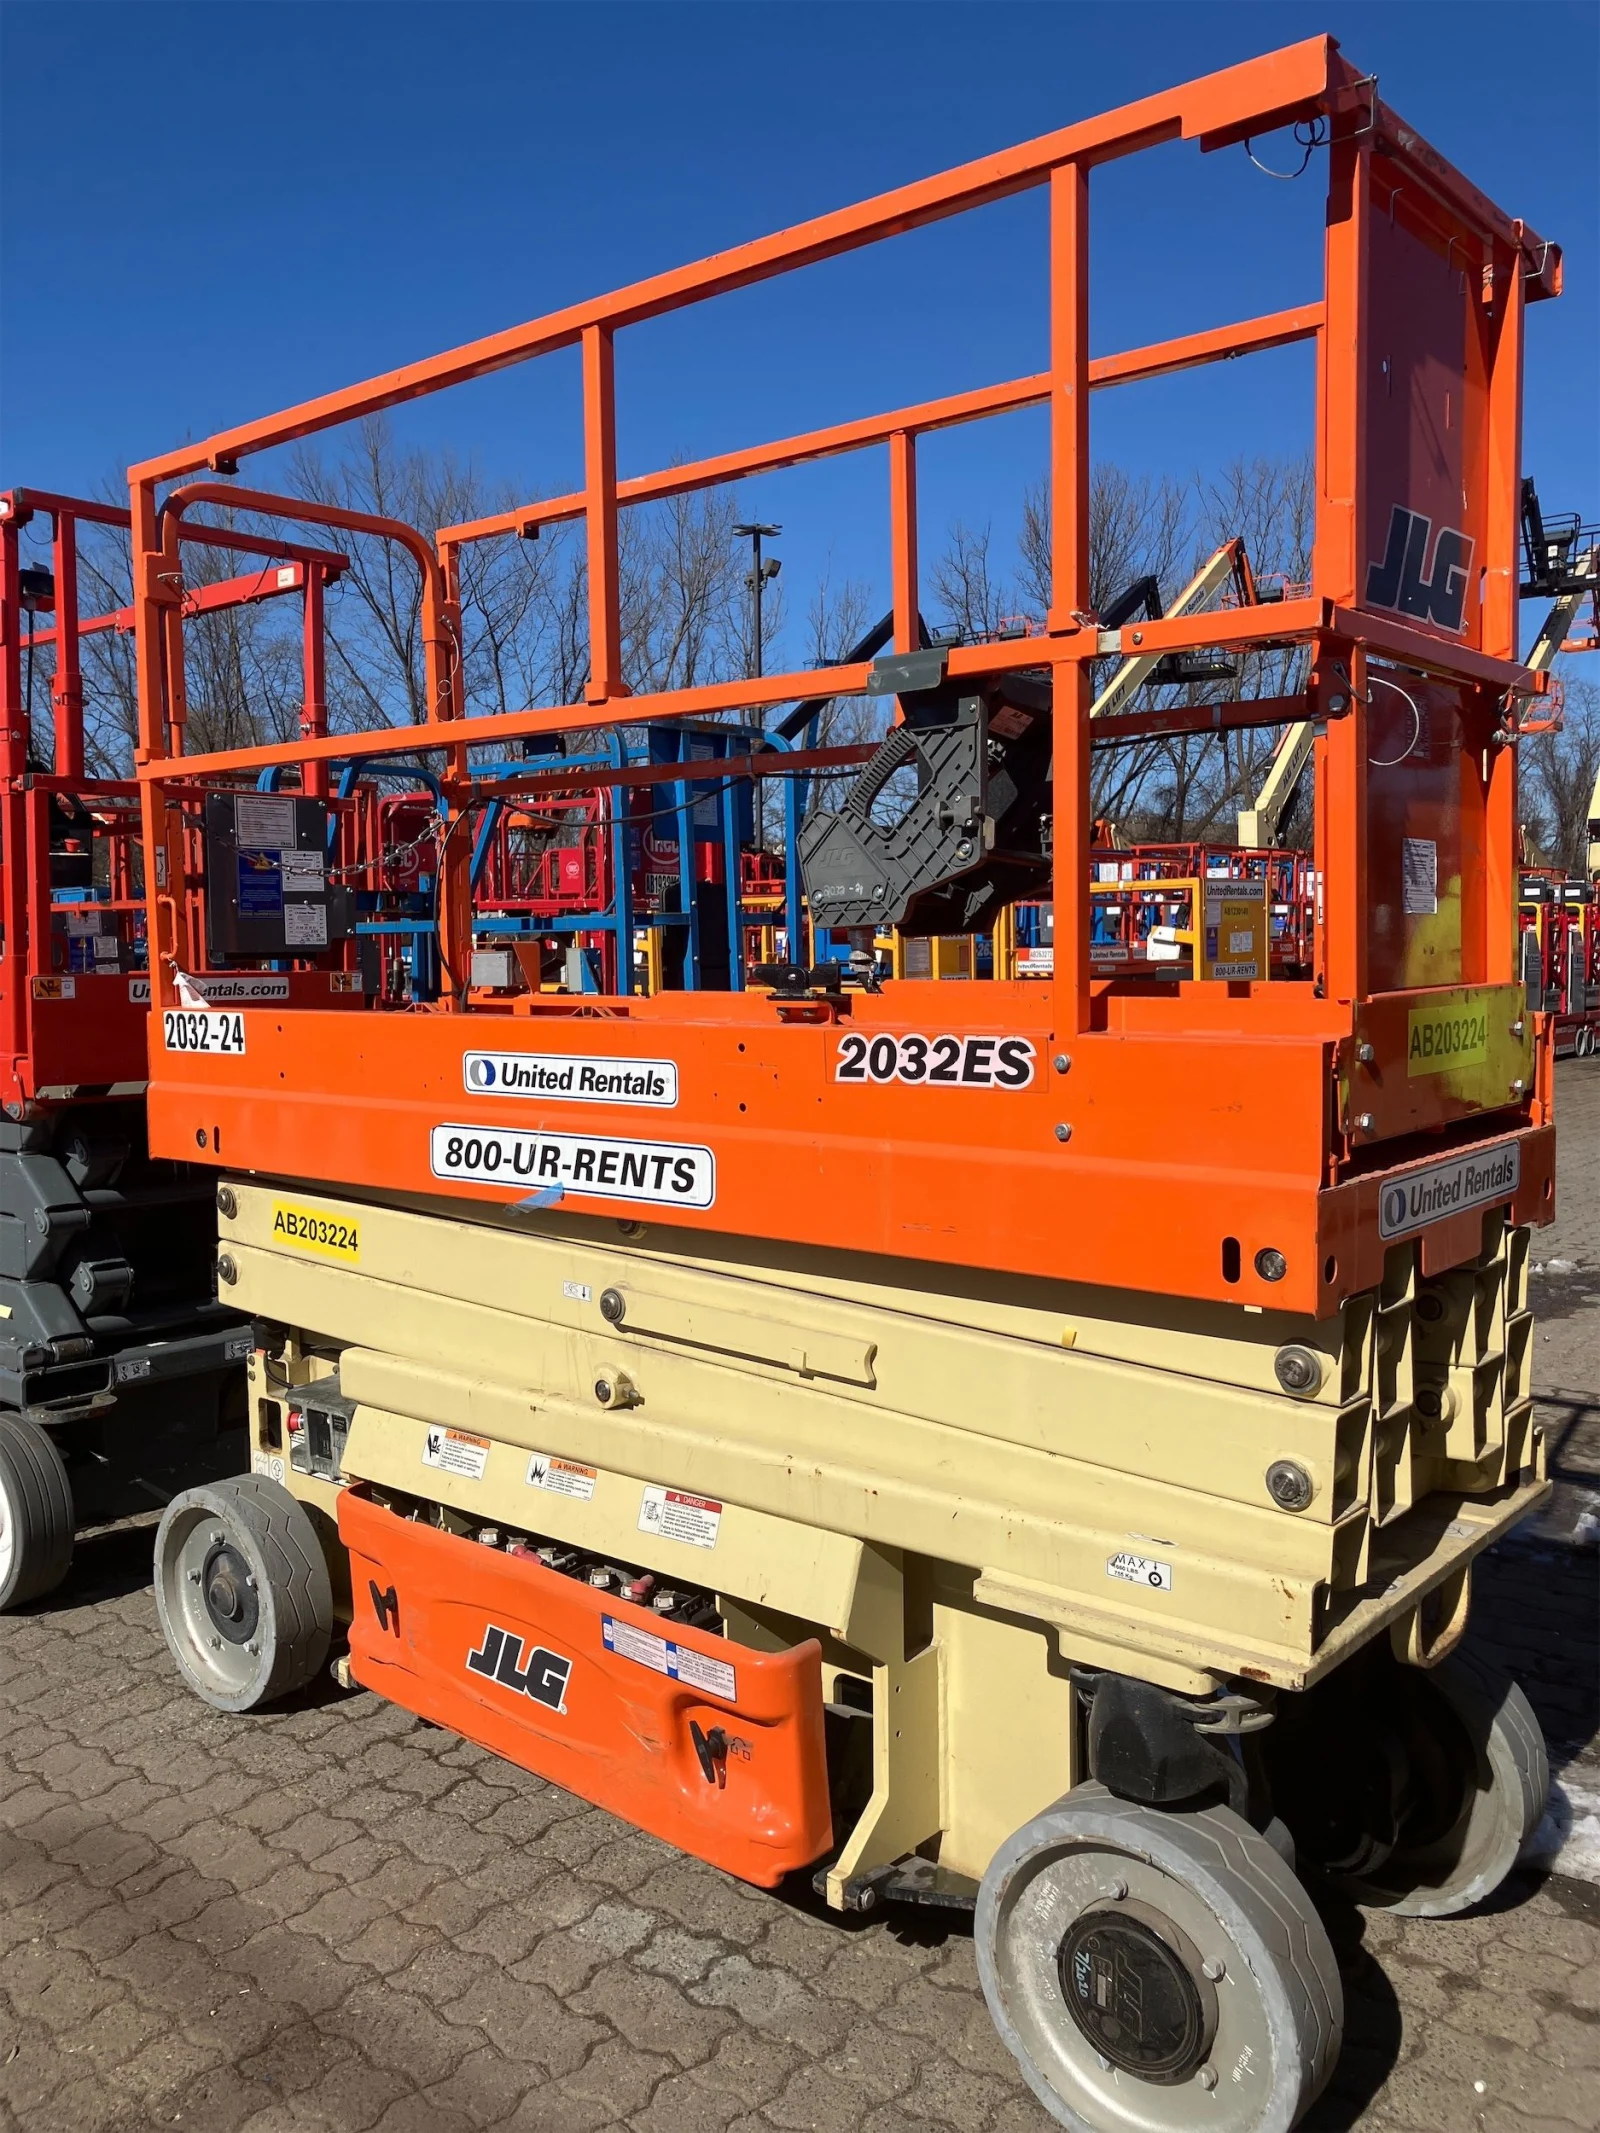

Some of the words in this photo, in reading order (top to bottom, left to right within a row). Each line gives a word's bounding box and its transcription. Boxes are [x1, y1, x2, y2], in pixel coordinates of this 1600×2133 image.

[1365, 504, 1476, 634] JLG
[1207, 884, 1263, 896] UnitedRentals.com
[165, 1014, 244, 1052] 2032-24
[1410, 1016, 1486, 1060] AB203224
[501, 1062, 574, 1092] United
[580, 1069, 665, 1097] Rentals
[839, 1036, 1033, 1086] 2032ES
[445, 1137, 696, 1193] 800-UR-RENTS
[1410, 1174, 1461, 1218] United
[1464, 1154, 1514, 1198] Rentals
[274, 1210, 358, 1251] AB203224
[458, 1433, 481, 1446] WARNING
[562, 1463, 588, 1475] WARNING
[684, 1496, 706, 1508] DANGER
[1114, 1555, 1146, 1570] MAX
[467, 1625, 571, 1711] JLG
